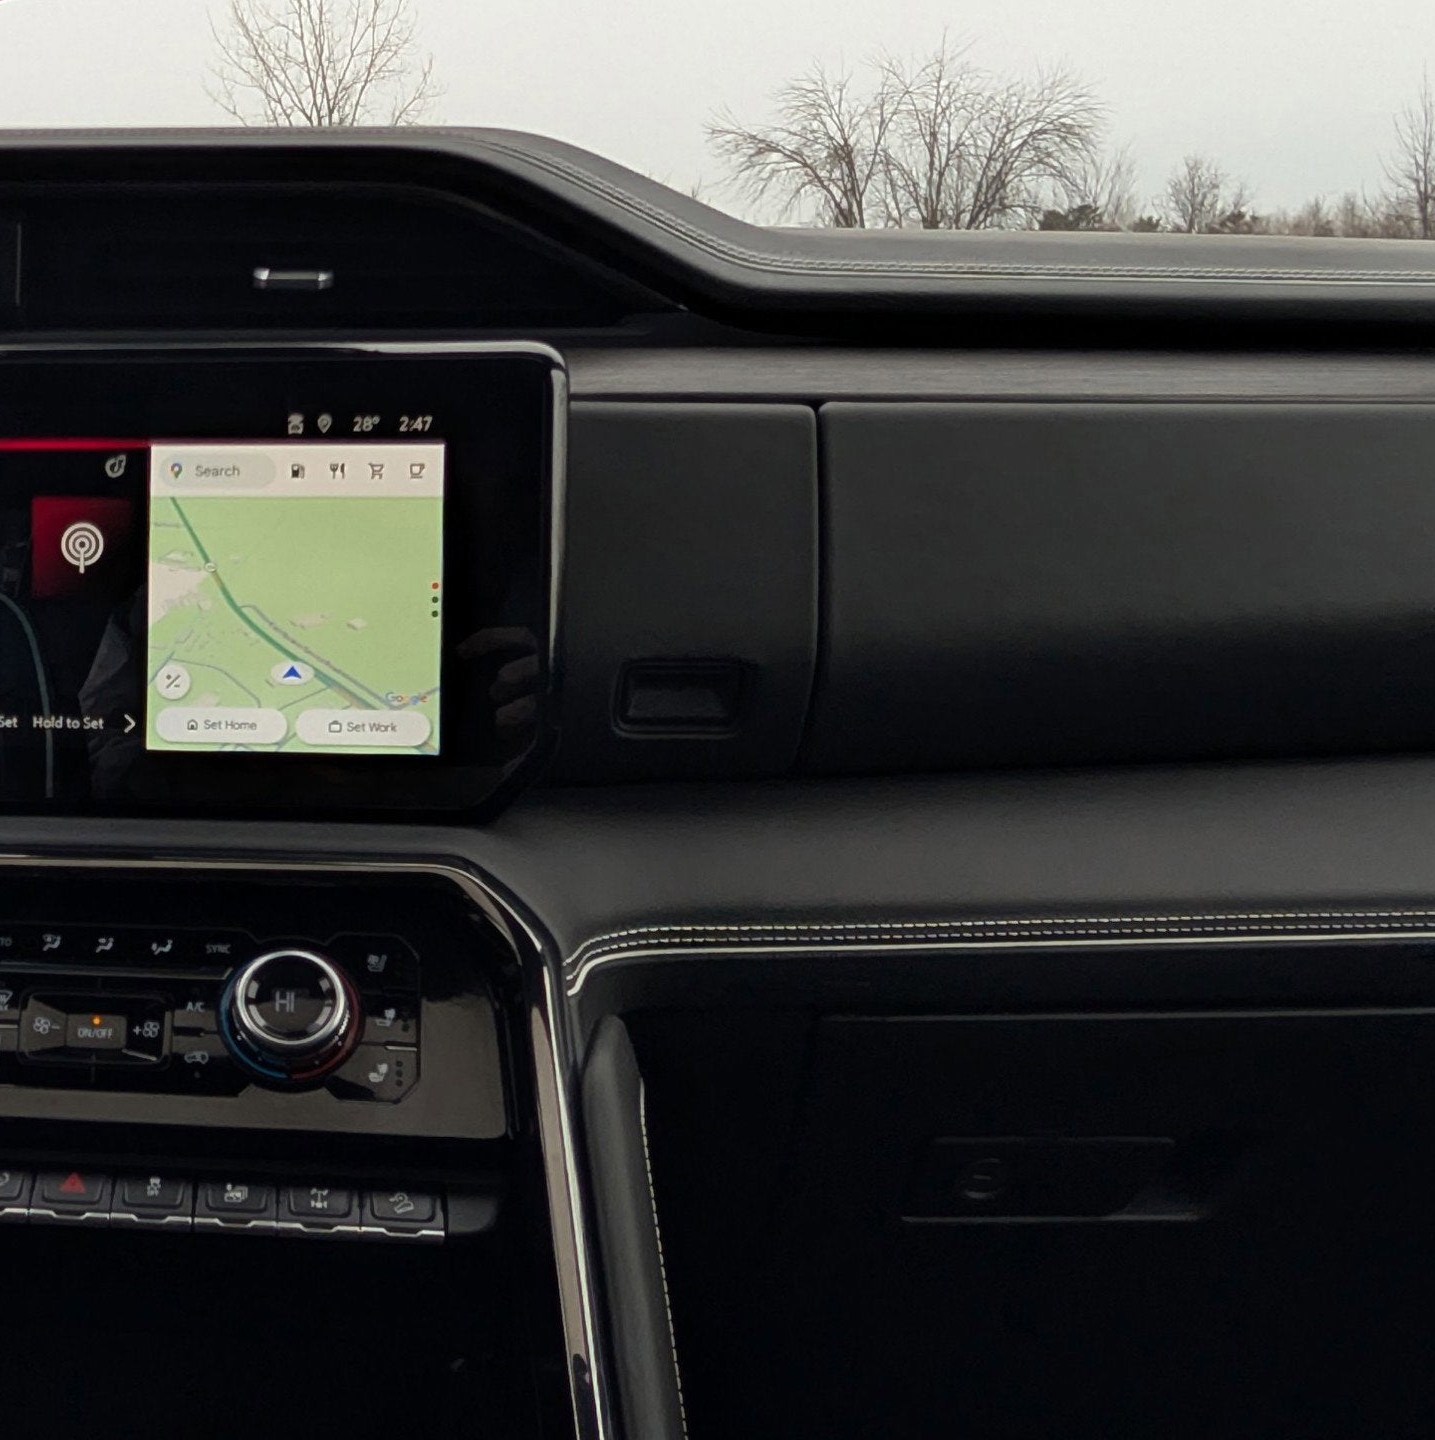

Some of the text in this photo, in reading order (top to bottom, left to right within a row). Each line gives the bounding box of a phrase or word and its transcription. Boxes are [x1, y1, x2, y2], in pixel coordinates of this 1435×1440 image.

[194, 464, 241, 478] Search
[32, 715, 105, 730] Hold to Set
[203, 719, 258, 731] Set Home
[346, 721, 398, 733] Set Work
[185, 1001, 206, 1013] A/C
[274, 989, 297, 1013] HI
[76, 1027, 114, 1040] ON/OFF
